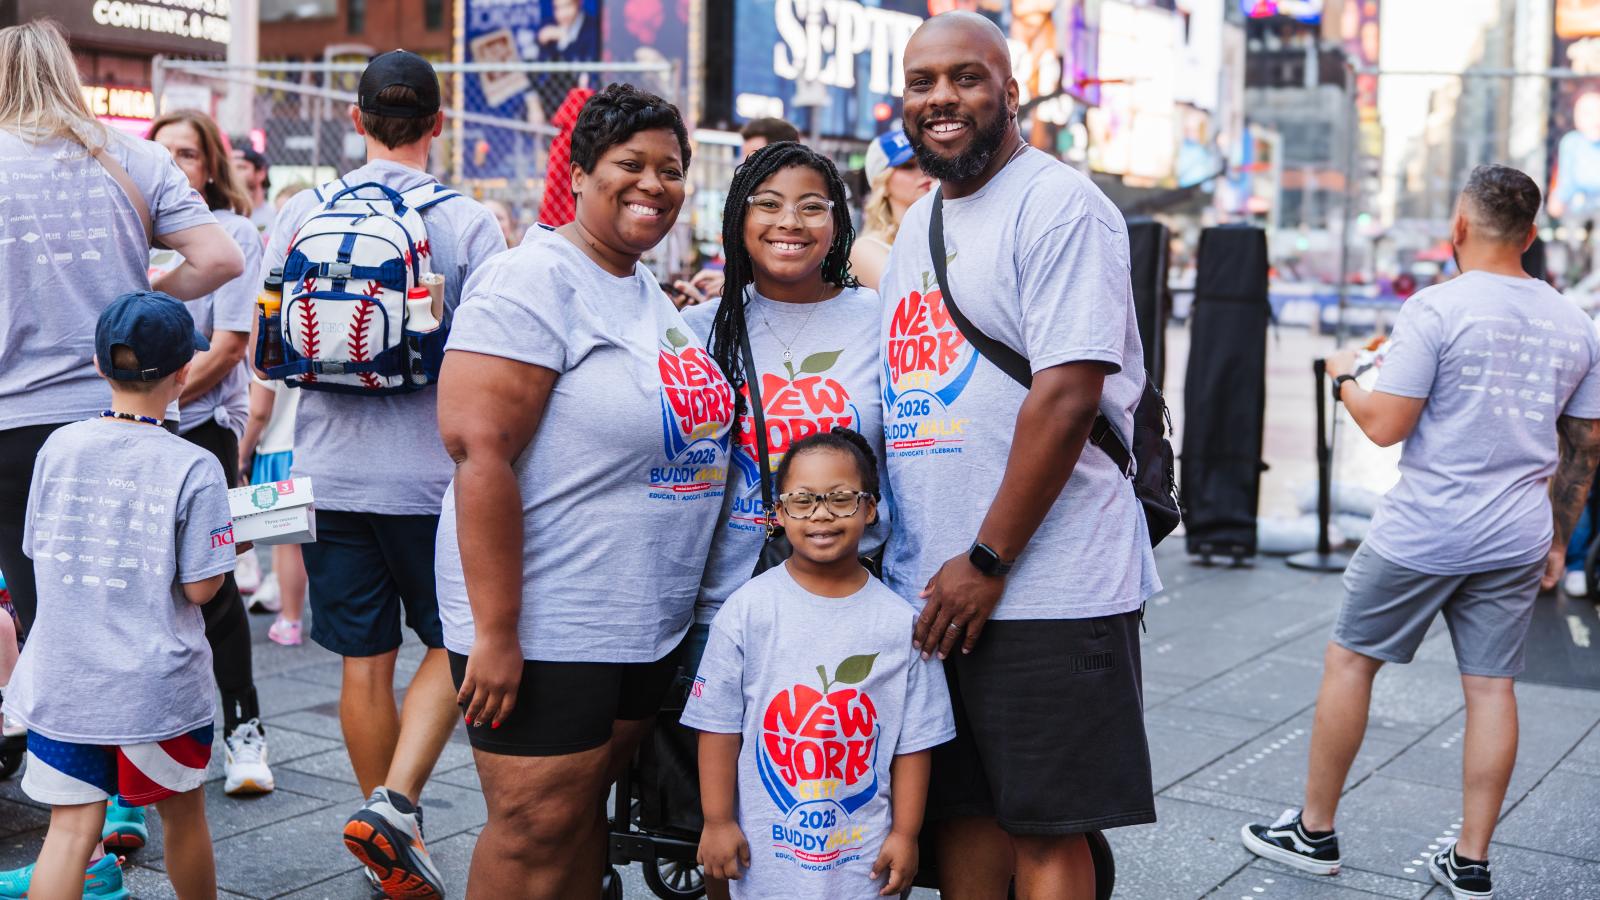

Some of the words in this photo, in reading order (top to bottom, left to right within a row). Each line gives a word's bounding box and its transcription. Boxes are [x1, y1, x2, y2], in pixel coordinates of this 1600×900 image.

[889, 290, 959, 338] NEW
[658, 347, 723, 386] NEW
[888, 331, 965, 385] YORK
[664, 382, 735, 435] YORK
[738, 373, 850, 416] NEW
[897, 399, 930, 418] 2026
[682, 447, 716, 465] 2026
[107, 478, 137, 491] VOYA
[649, 492, 676, 501] EDUCATE
[763, 684, 877, 738] NEW
[764, 732, 875, 787] YORK
[799, 808, 836, 829] 2026
[801, 863, 832, 871] ADVOCATE
